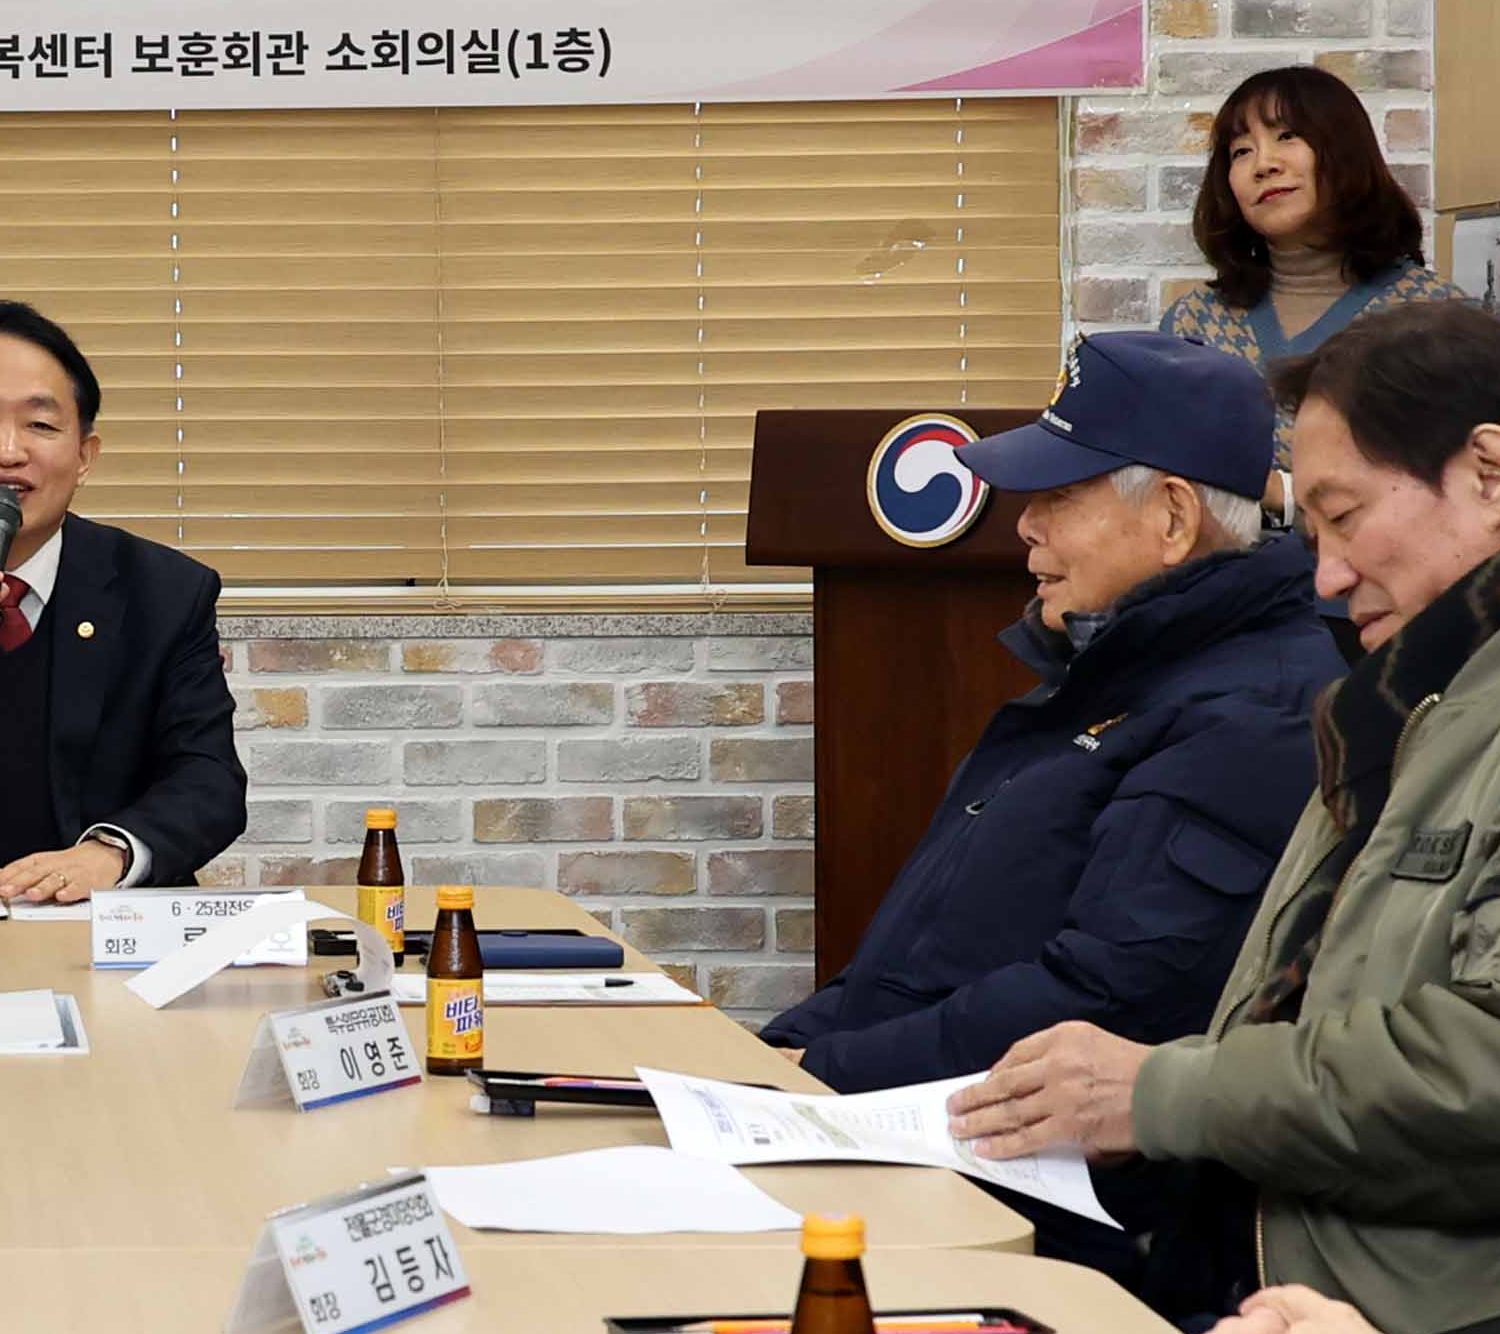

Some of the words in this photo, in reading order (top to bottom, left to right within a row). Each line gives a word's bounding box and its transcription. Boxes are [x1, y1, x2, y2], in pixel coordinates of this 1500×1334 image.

[131, 30, 310, 77] 보훈회관
[325, 27, 611, 79] 소회의실(1층)
[105, 938, 137, 955] 회장
[446, 994, 479, 1018] 비타
[297, 1069, 320, 1091] 회장
[309, 1291, 342, 1323] 회장
